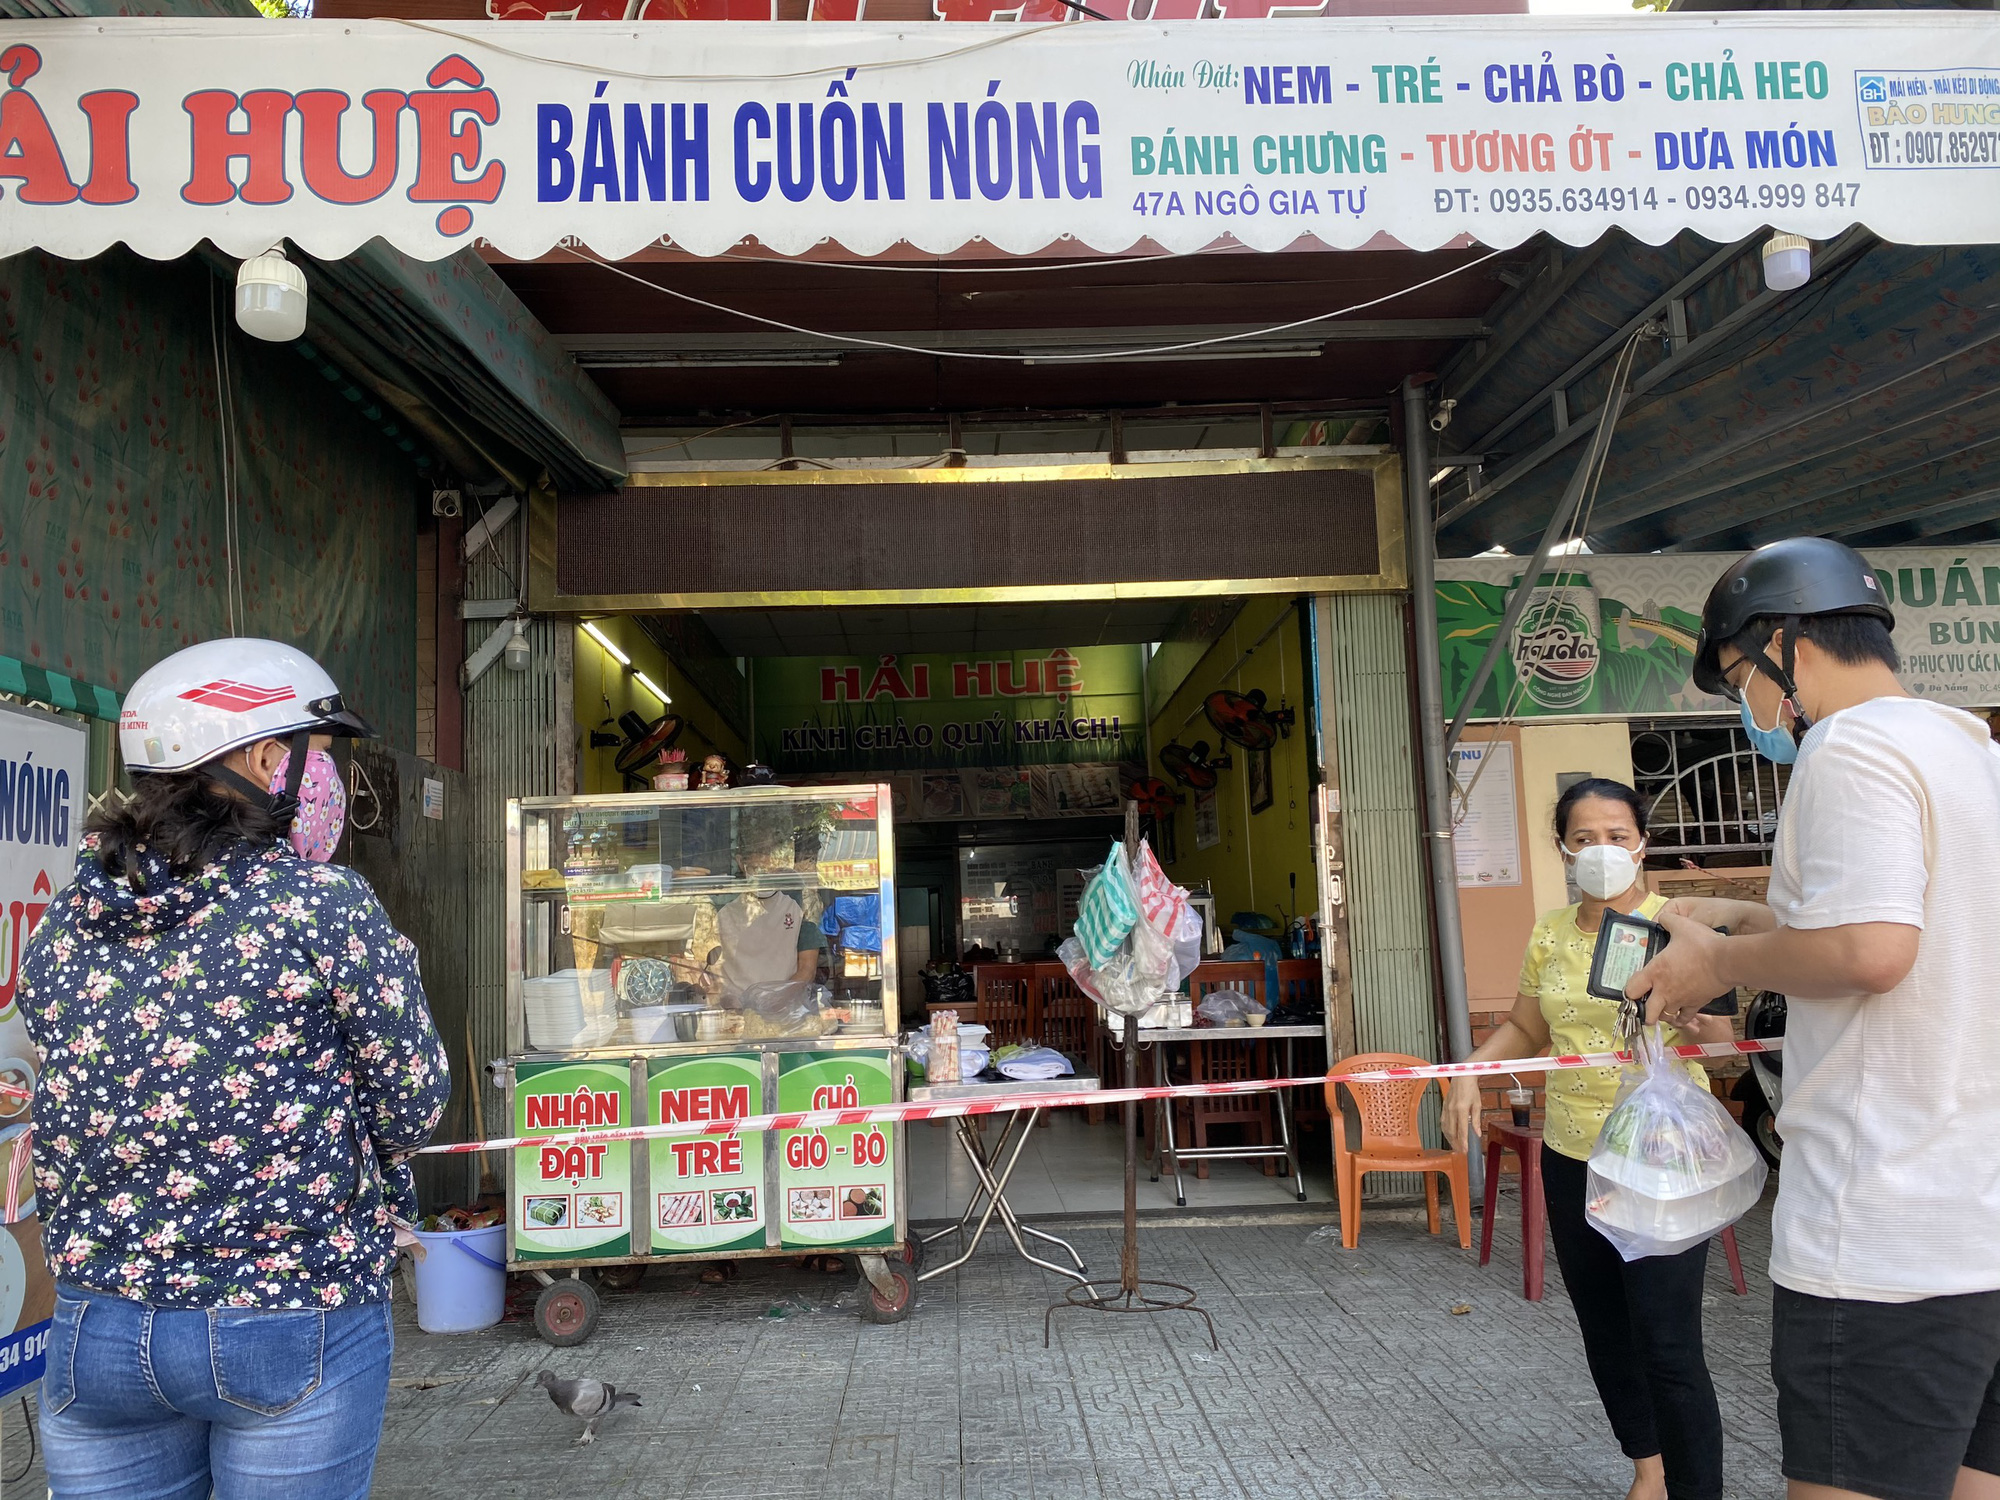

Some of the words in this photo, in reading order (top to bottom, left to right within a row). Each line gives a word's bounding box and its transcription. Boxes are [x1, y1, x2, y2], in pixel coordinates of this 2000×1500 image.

[1126, 59, 1186, 94] Nhận
[1193, 59, 1239, 94] Đặt:
[1243, 65, 1332, 105] NEM
[1371, 56, 1443, 104] TRÉ
[1484, 50, 1562, 103] CHẢ
[1573, 53, 1625, 103] BÒ
[1665, 48, 1744, 101] CHẢ
[1754, 60, 1829, 101] HEO
[1969, 77, 1977, 95] DI
[1867, 100, 1927, 126] BẢO
[181, 53, 505, 237] HUỆ
[537, 81, 710, 203] BÁNH
[734, 68, 906, 203] CUỐN
[926, 81, 1102, 201] NÓNG
[1130, 127, 1239, 176] BÁNH
[1252, 130, 1387, 175] CHƯNG
[1426, 129, 1556, 173] TƯƠNG
[1568, 124, 1614, 172] ỚT
[1654, 127, 1735, 171] DƯA
[1745, 121, 1838, 169] MÓN
[1905, 131, 2000, 164] 0907.85297
[1132, 191, 1185, 216] 47A
[1194, 183, 1260, 216] NGÔ
[1268, 190, 1320, 215] GIA
[1328, 185, 1368, 219] TỰ
[1434, 188, 1480, 213] ĐT:
[1489, 187, 1658, 213] 0935.634914
[1685, 183, 1806, 211] 0934.999
[1815, 182, 1861, 209] 847
[1929, 616, 2000, 645] BÚN
[819, 653, 931, 703] HẢI
[952, 648, 1085, 703] HUỆ
[1910, 654, 1944, 678] PHỤC
[1946, 653, 1964, 678] VỤ
[1967, 650, 1991, 672] CÁC
[127, 721, 149, 731] MINH
[782, 720, 846, 752] KÍNH
[855, 717, 933, 750] CHÀO
[941, 711, 1005, 752] QUÝ
[1450, 750, 1482, 760] NU
[525, 1084, 620, 1133] NHẬN
[659, 1085, 750, 1124] NEM
[811, 1073, 859, 1111] CHẢ
[670, 1132, 743, 1178] TRÉ
[785, 1127, 830, 1170] GIÒ
[852, 1124, 887, 1168] BÒ
